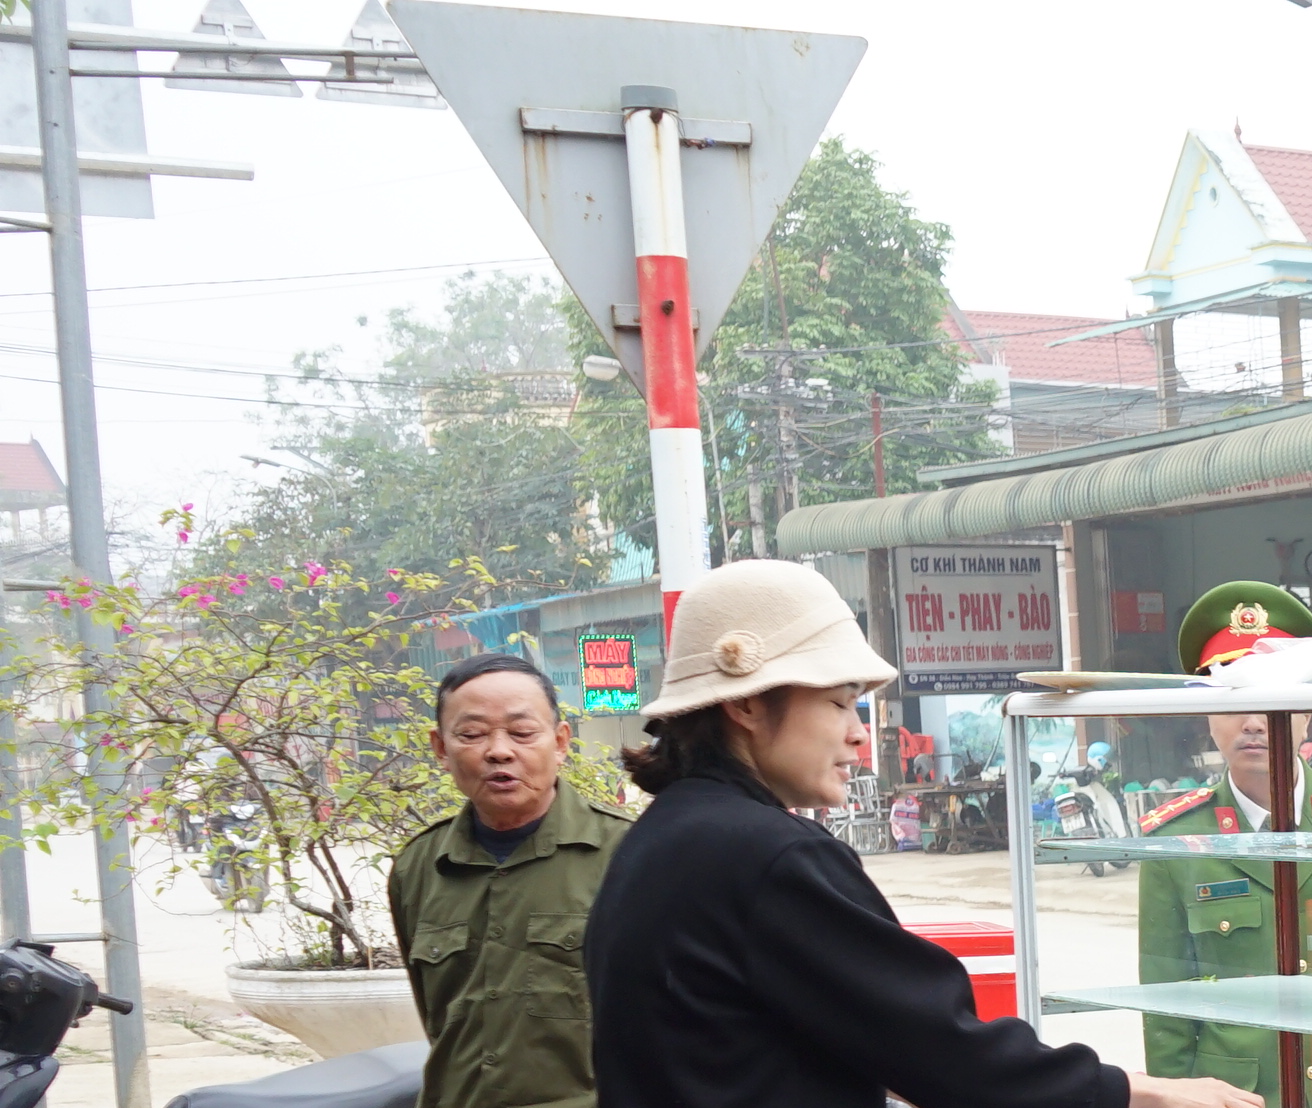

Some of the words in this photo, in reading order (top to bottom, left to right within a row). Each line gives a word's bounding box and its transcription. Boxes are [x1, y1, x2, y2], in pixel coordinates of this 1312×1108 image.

[911, 556, 930, 573] CƠ
[933, 553, 956, 573] KHÍ
[960, 554, 1006, 573] THÀNH
[1010, 557, 1042, 573] NAM
[905, 585, 945, 641] TIỆN
[958, 592, 1003, 632] PHAY
[1017, 584, 1052, 631] BÀO
[584, 637, 631, 664] MÁY
